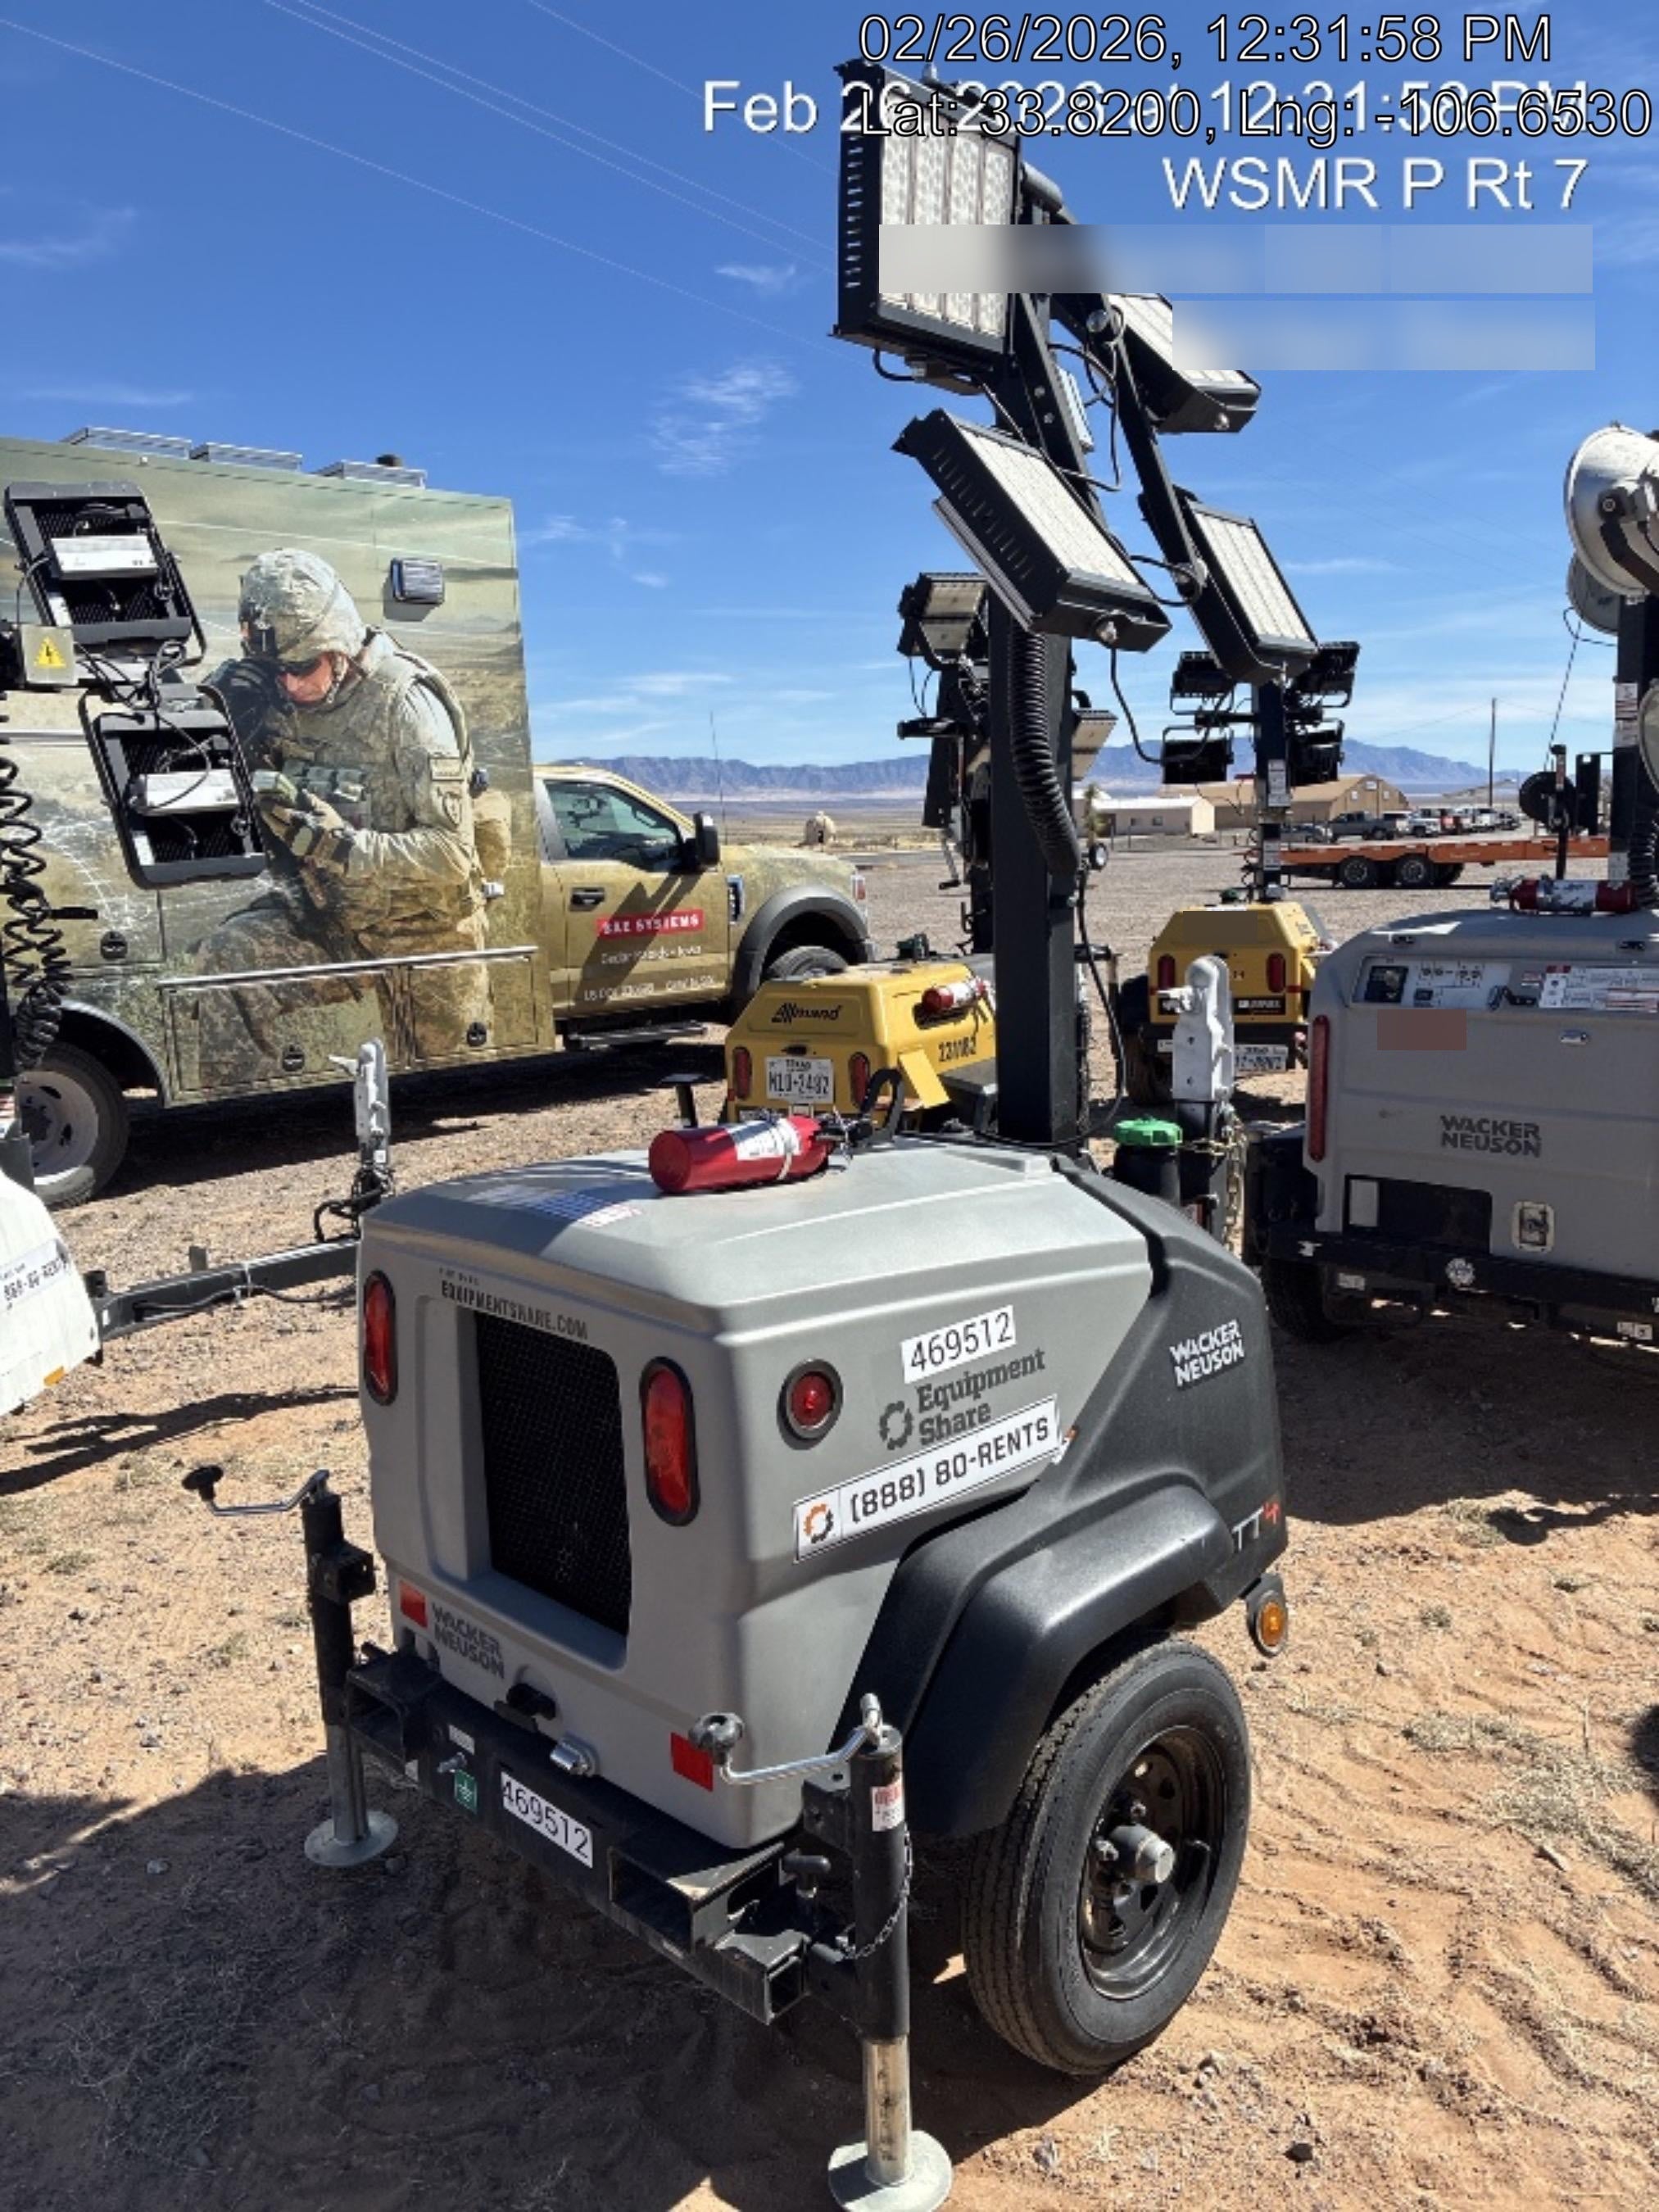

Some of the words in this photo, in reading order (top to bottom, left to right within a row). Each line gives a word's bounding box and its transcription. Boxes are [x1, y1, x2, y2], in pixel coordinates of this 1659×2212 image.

[1439, 1115, 1541, 1140] WACKER
[1440, 1132, 1542, 1158] NEUSON
[442, 1280, 588, 1340] EQUIPMENTSHARE.COM
[910, 1312, 1013, 1371] 469512
[1169, 1319, 1242, 1364] WACKER
[1174, 1339, 1244, 1387] NEUSON
[914, 1349, 1046, 1414] Equipment
[918, 1402, 991, 1446] Share
[850, 1468, 926, 1523] (888)
[935, 1417, 1049, 1487] 80-RENTS
[432, 1602, 502, 1659] WACKER
[434, 1623, 505, 1679] NEUSON
[502, 1781, 588, 1859] 469512
